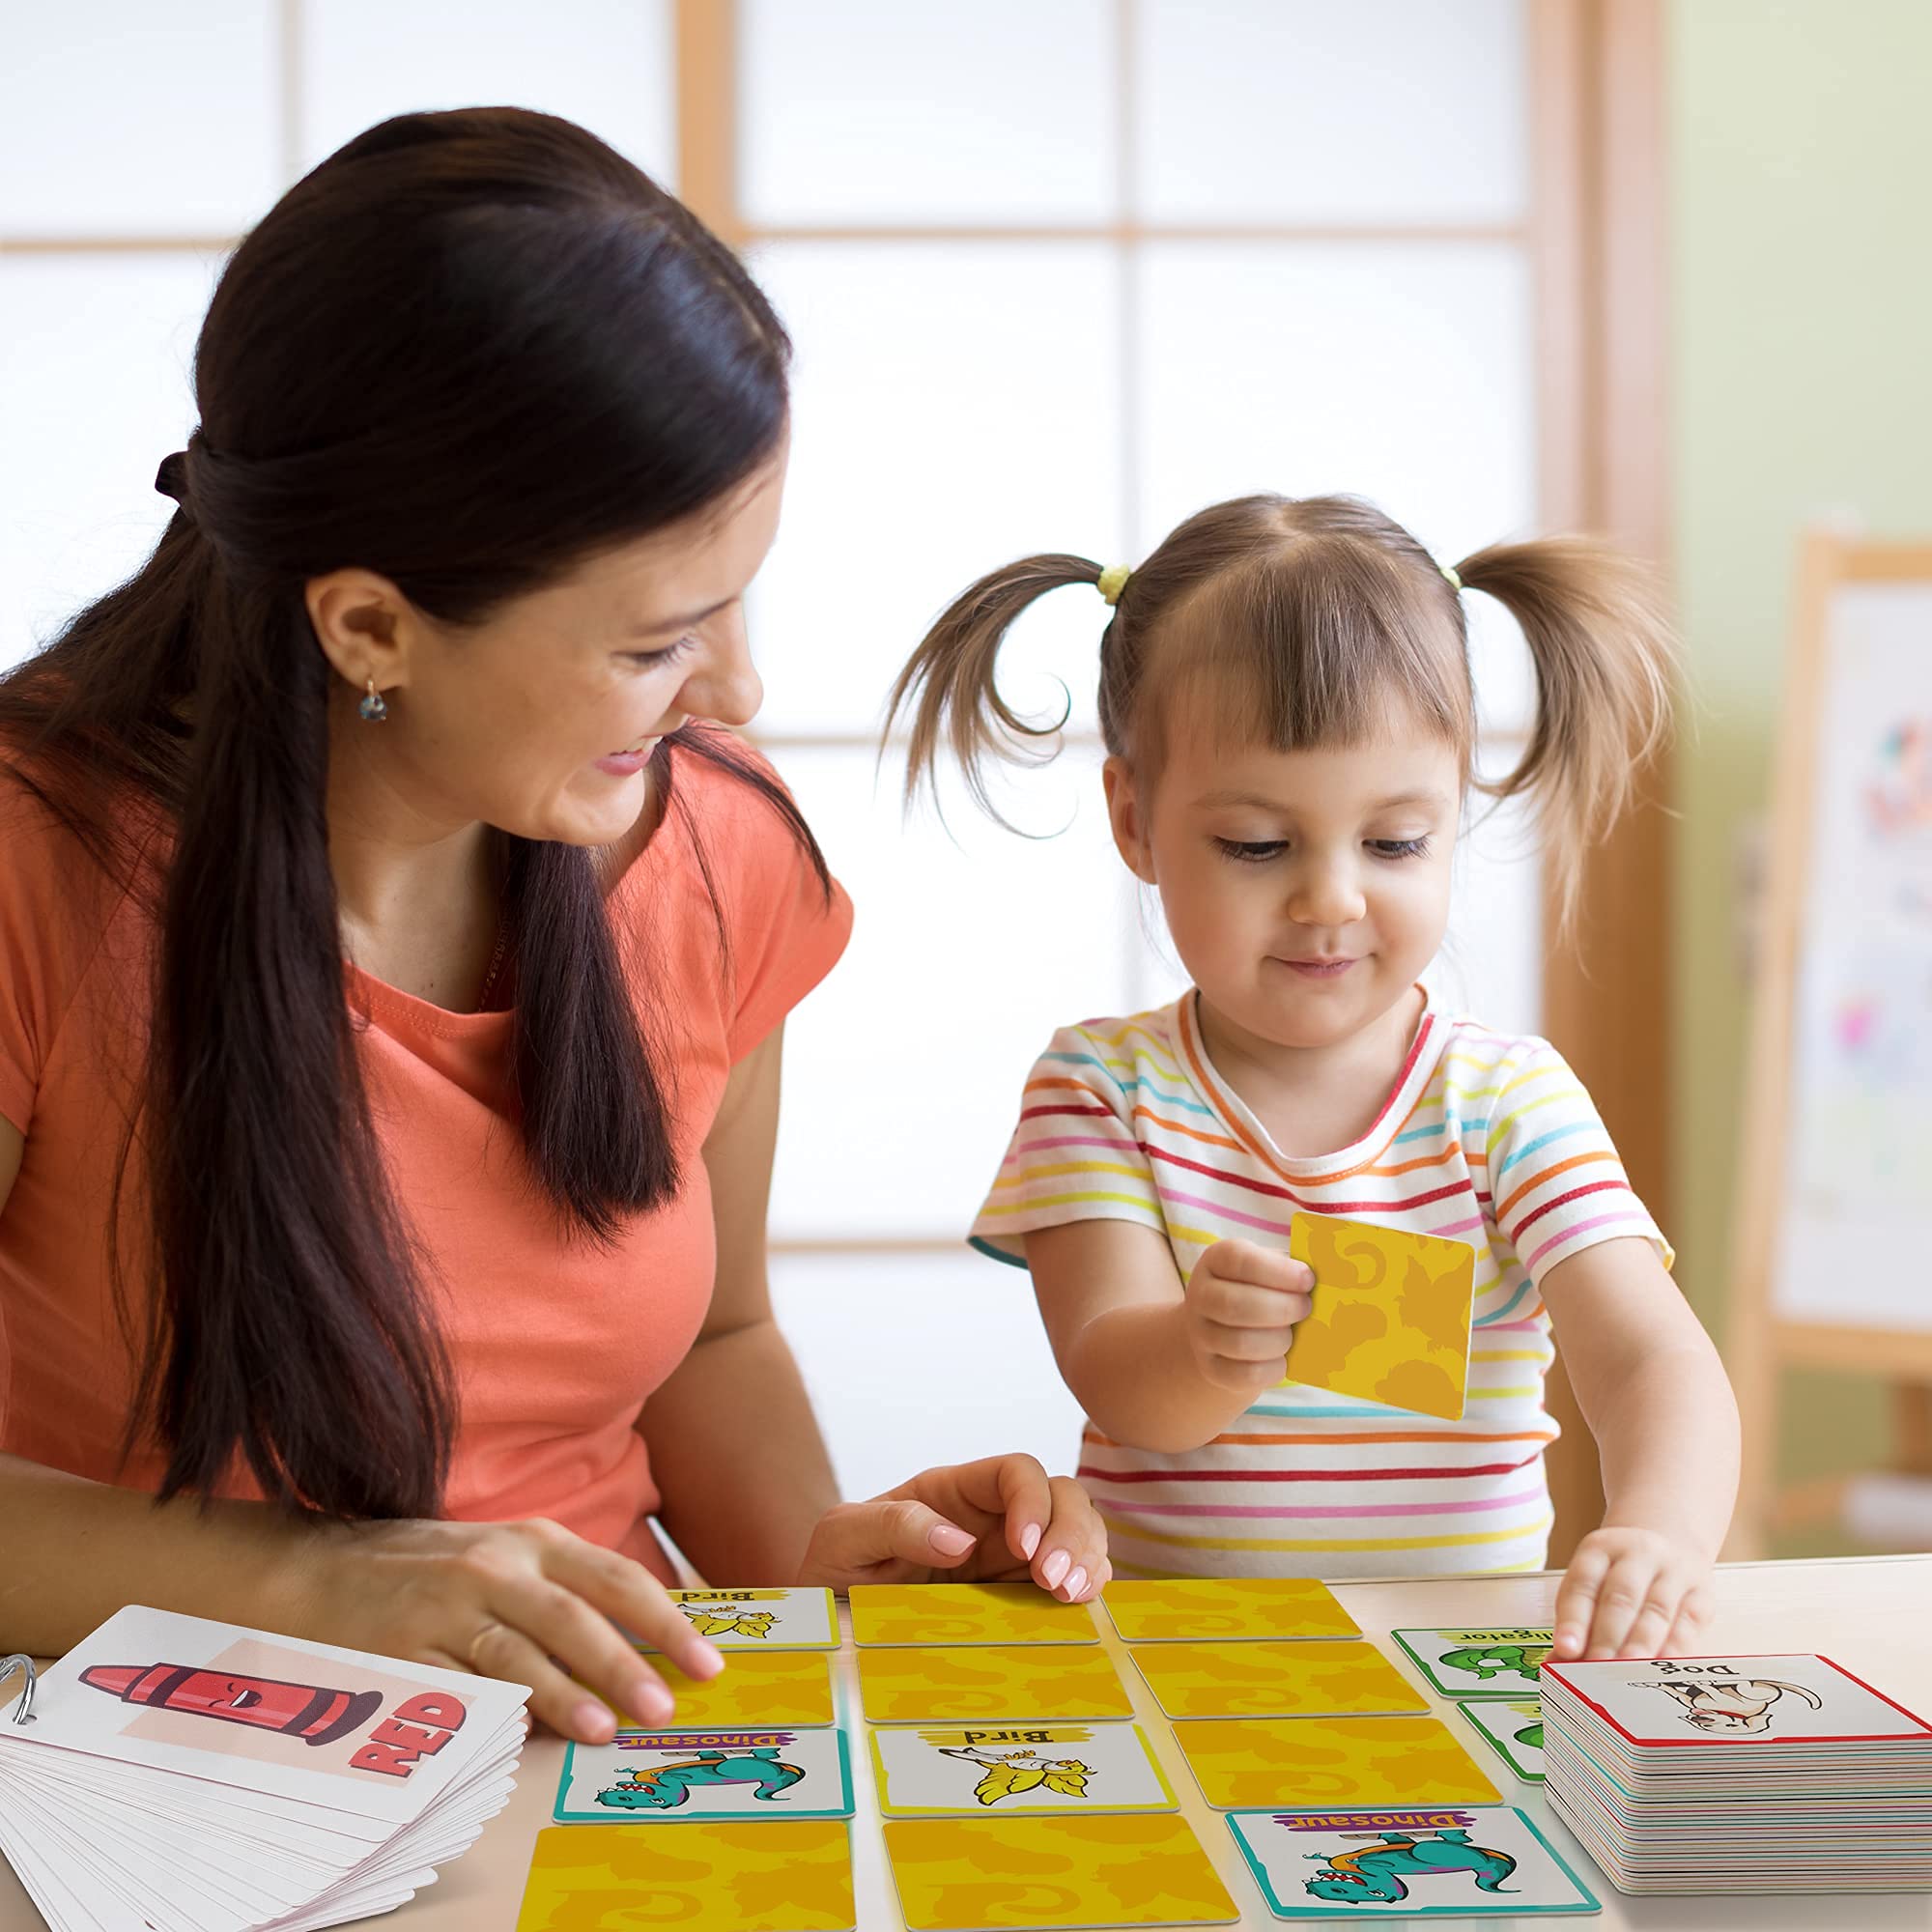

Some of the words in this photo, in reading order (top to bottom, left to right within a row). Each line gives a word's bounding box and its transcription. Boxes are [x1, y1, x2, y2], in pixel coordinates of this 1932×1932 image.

[681, 1591, 756, 1602] Bird
[1460, 1629, 1553, 1640] ligator
[1650, 1661, 1740, 1675] Dog
[348, 1691, 467, 1777] RED
[964, 1731, 1055, 1744] Bird
[621, 1735, 781, 1747] Dinosaur
[1288, 1814, 1463, 1828] Dinosaur
